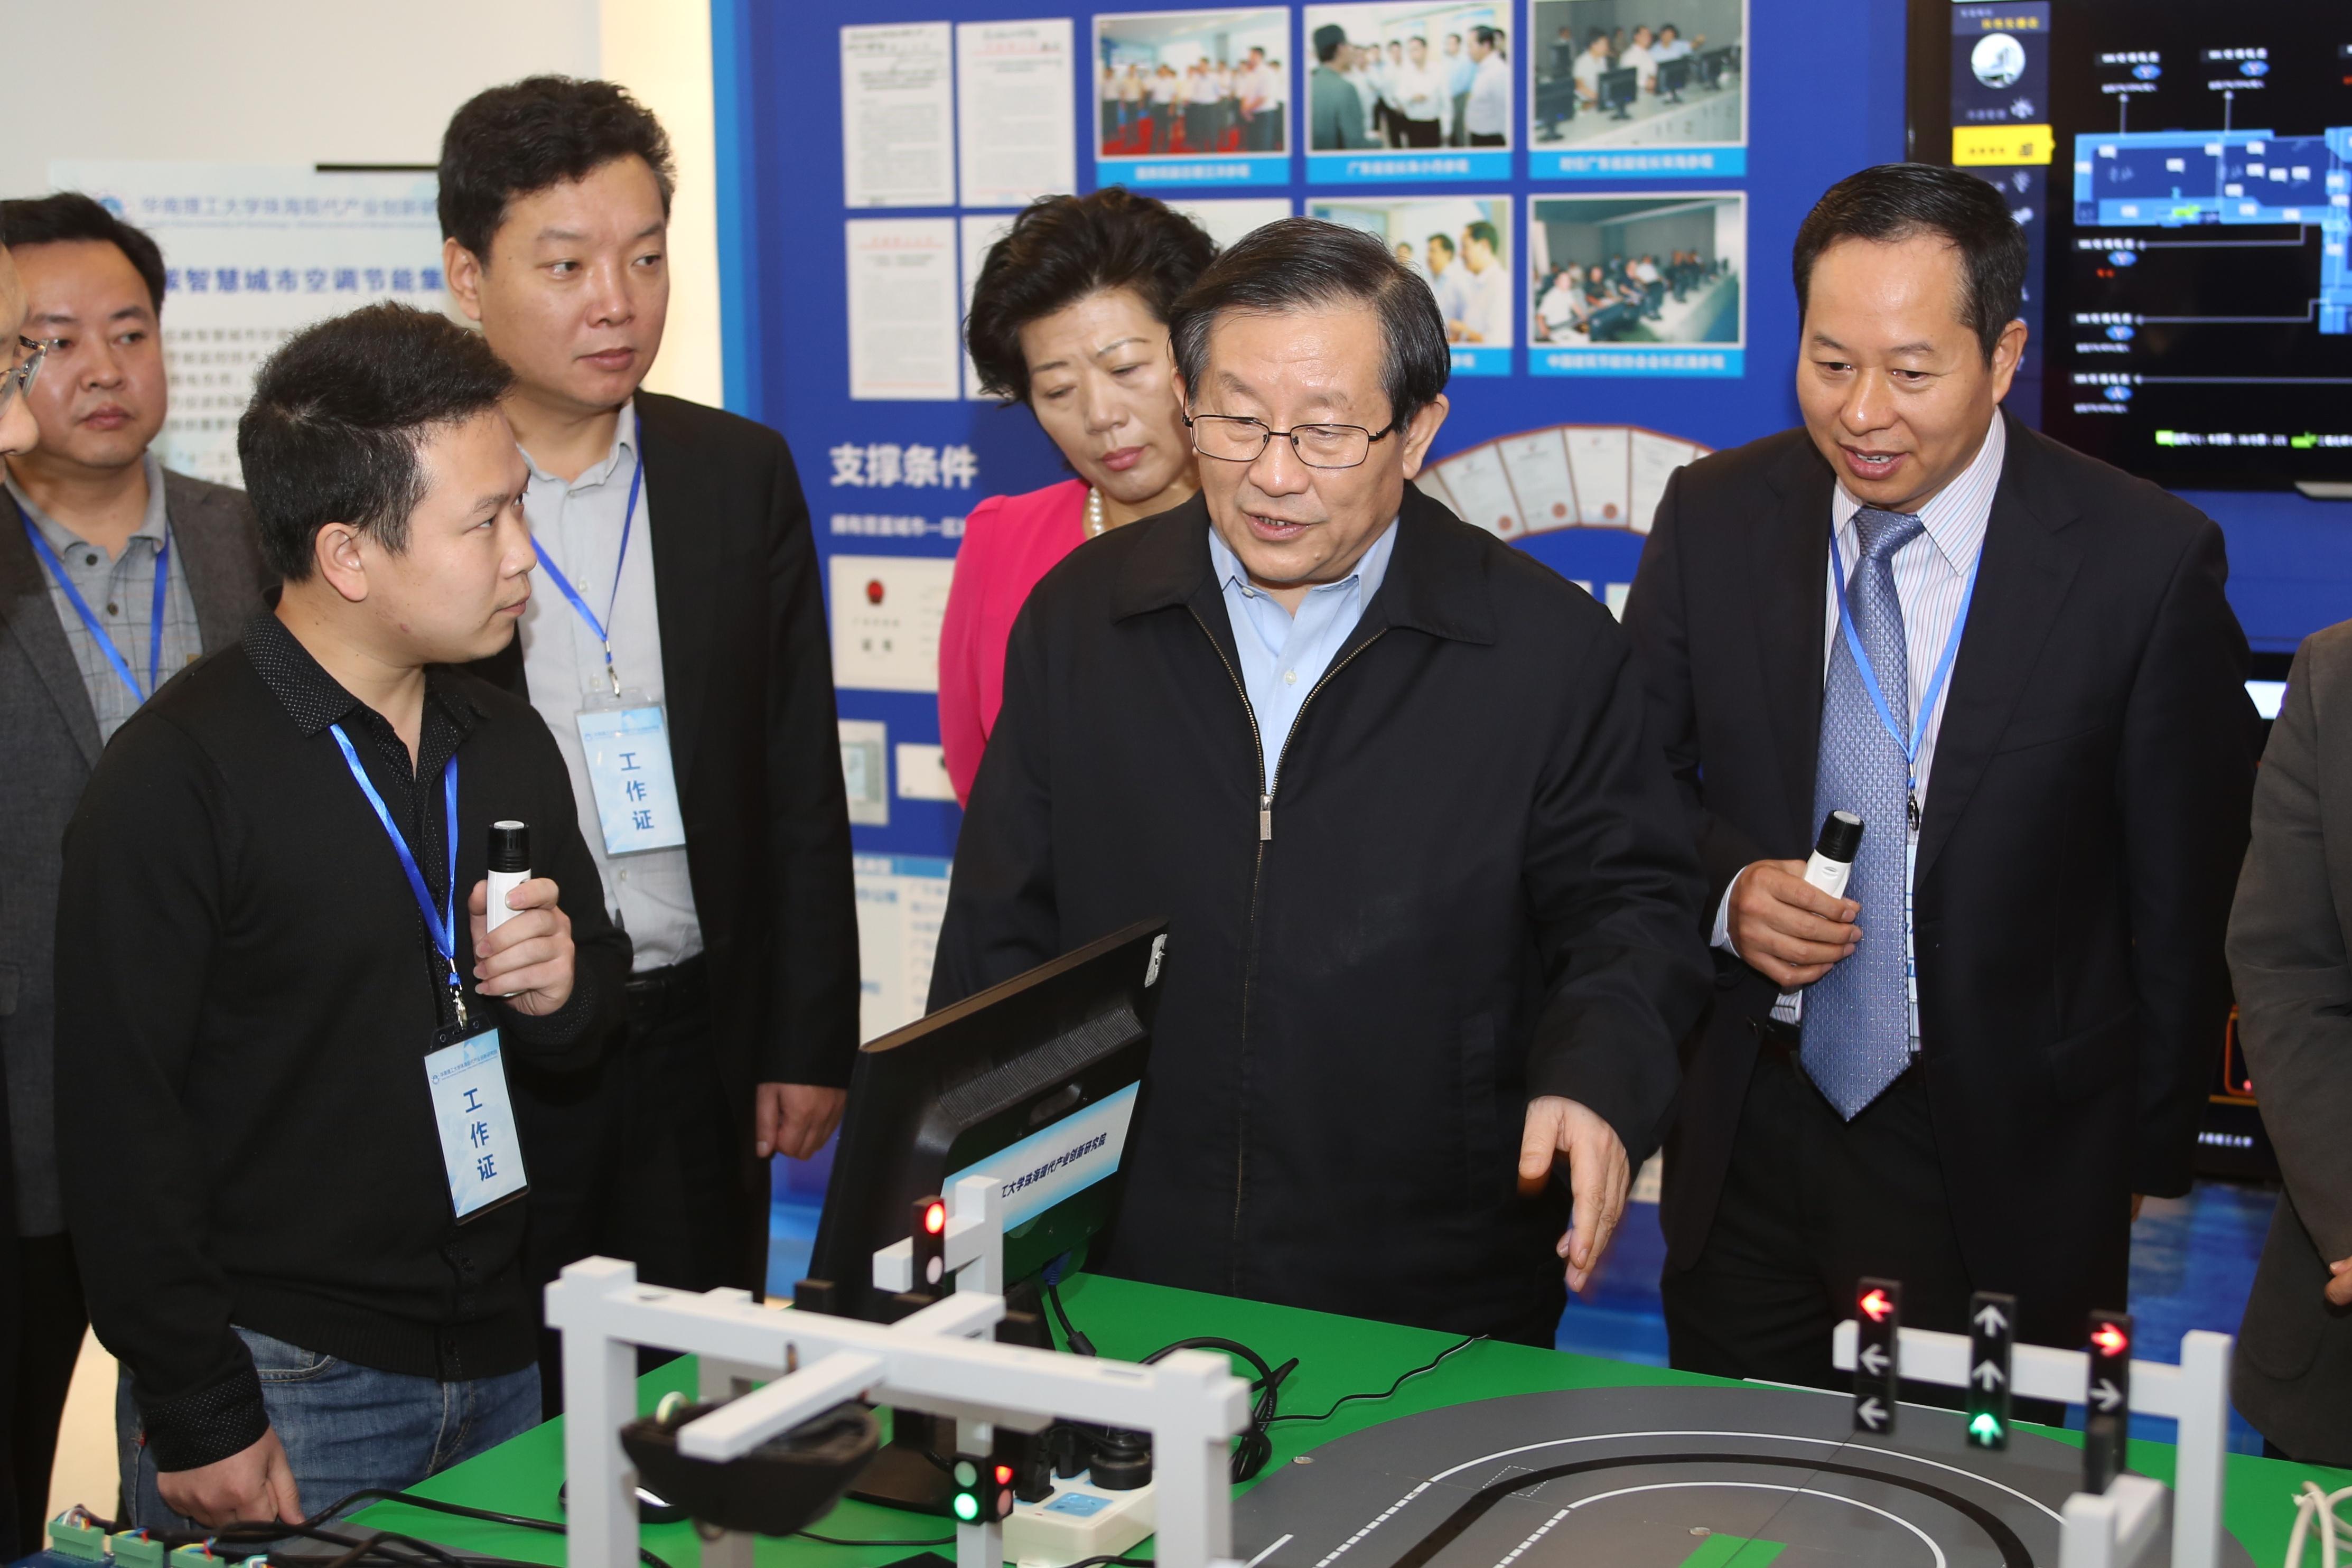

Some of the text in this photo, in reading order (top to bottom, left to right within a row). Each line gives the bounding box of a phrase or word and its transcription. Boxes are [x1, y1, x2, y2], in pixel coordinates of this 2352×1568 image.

[829, 442, 977, 489] 支撑条件
[619, 752, 655, 830] 工作证
[463, 1087, 497, 1182] 工作证
